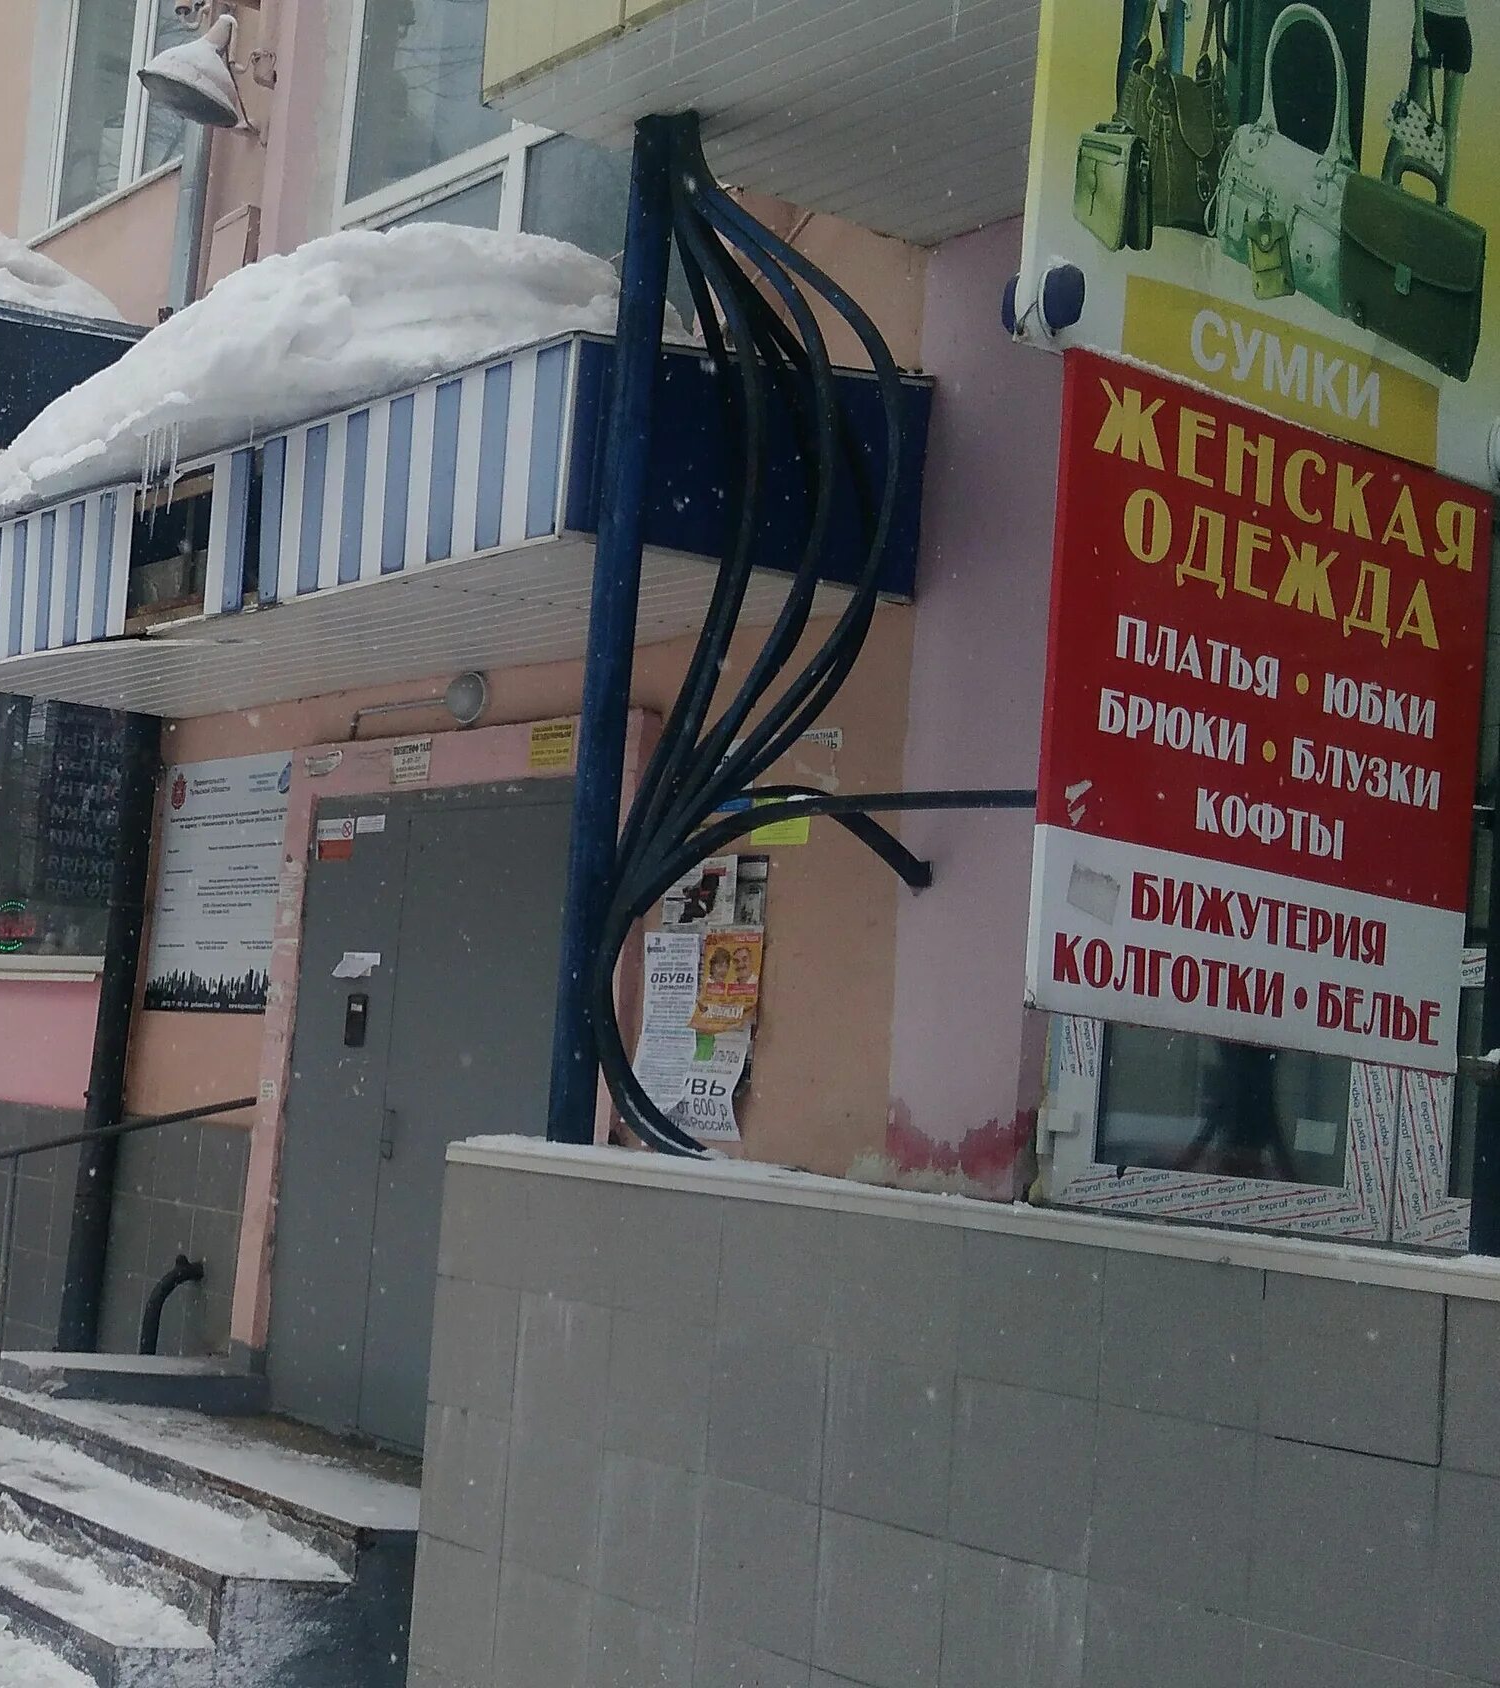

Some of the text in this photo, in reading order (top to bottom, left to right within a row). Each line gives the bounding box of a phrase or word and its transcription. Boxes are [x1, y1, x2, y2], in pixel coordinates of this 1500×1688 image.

[1190, 309, 1381, 428] СУМКИ
[1093, 377, 1477, 573] ЖЕНСКАЯ
[1123, 487, 1440, 650] ОДЕЖДА
[1115, 614, 1436, 739] ПЛАТЬЯ ЮБКИ
[1098, 687, 1441, 811] БРЮКИ БЛУЗКИ
[1195, 787, 1345, 861] КОФТЫ
[1130, 871, 1387, 967] БИЖУТЕРИЯ
[650, 973, 695, 983] ОБУВЬ
[1052, 932, 1441, 1046] КОЛГОТКИ БЕЛЬЕ
[693, 1098, 716, 1116] 600
